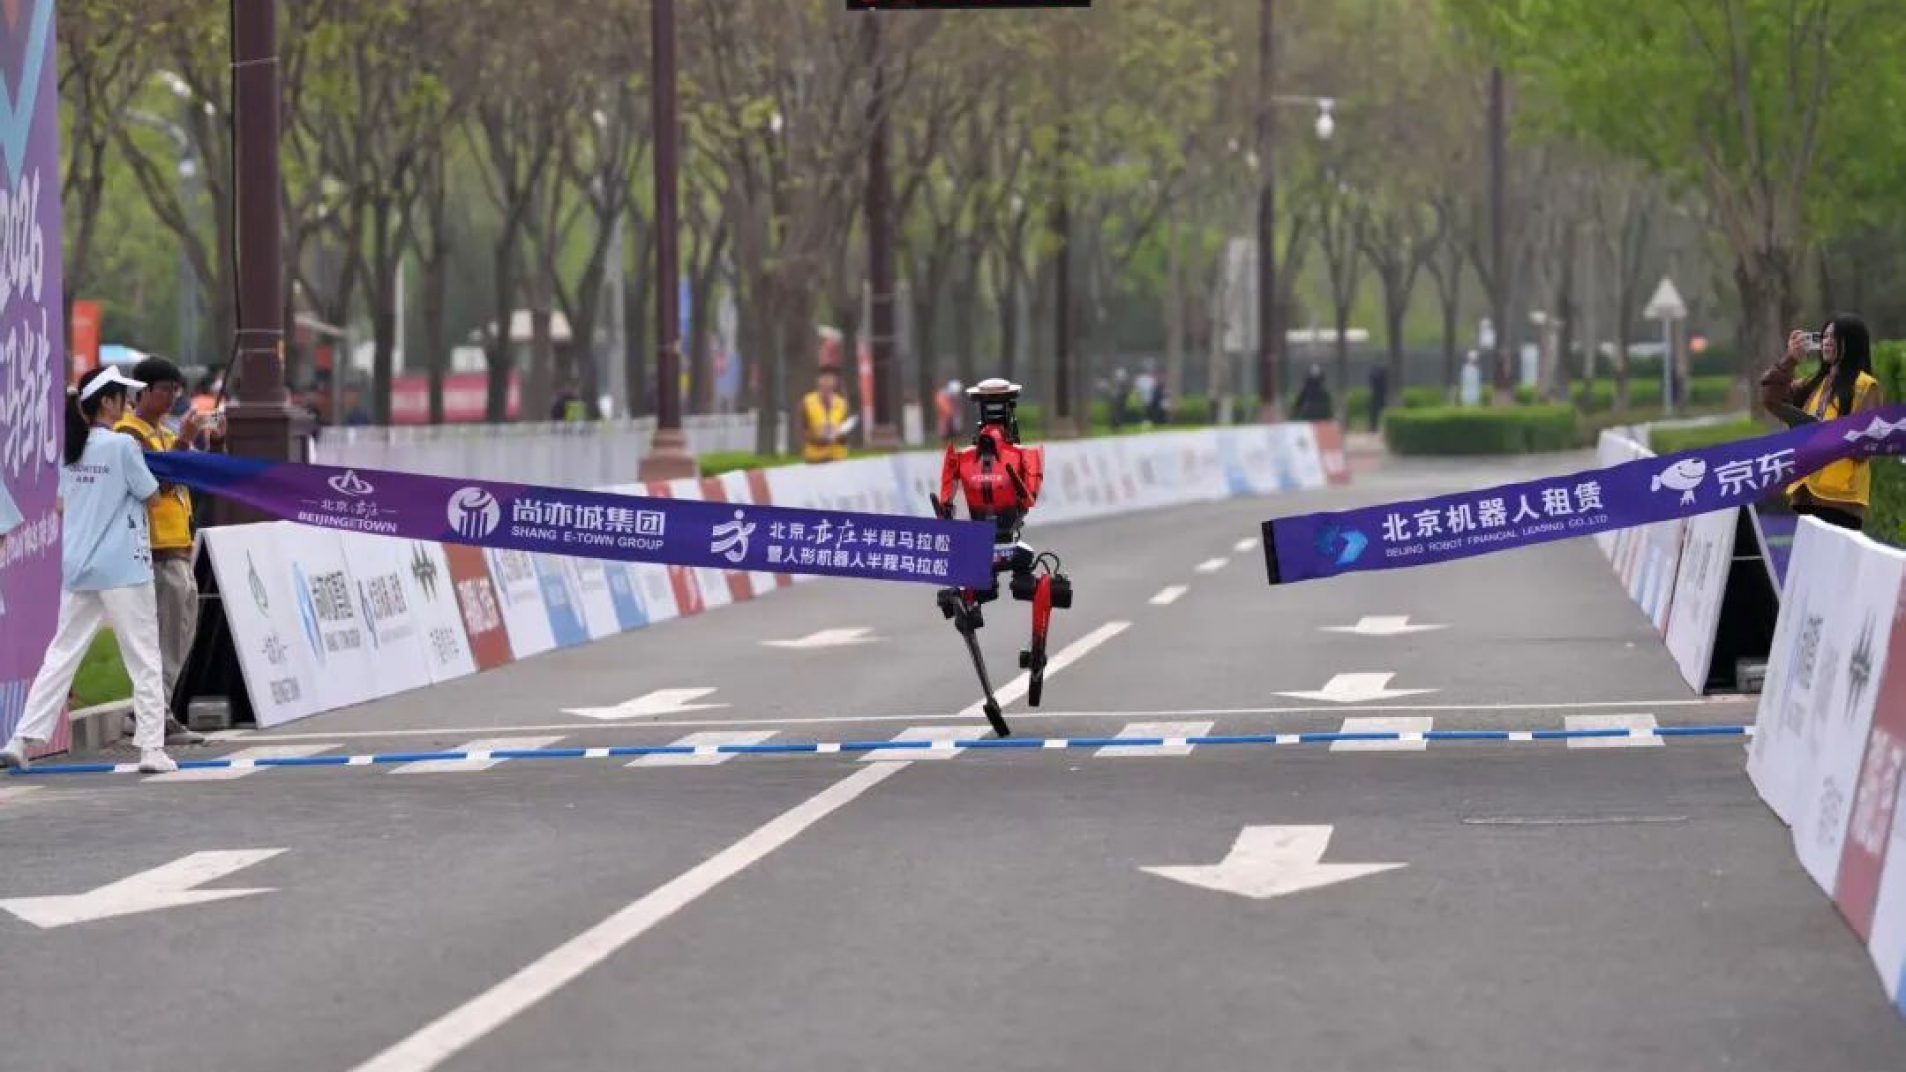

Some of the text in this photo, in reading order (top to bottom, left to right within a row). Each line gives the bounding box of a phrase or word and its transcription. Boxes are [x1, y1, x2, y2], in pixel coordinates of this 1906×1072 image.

[1714, 448, 1796, 497] 京东
[512, 498, 666, 536] 尚亦城集团
[1382, 481, 1604, 542] 北京机器人租赁
[511, 525, 664, 550] SHANG E-TOWN GROUP
[768, 518, 950, 552] 北京亦庄半程马拉松
[1386, 543, 1424, 557] BEIJING
[1429, 539, 1462, 552] ROBOT
[1467, 531, 1517, 545] FINANCIAL
[1523, 522, 1564, 535] LEASING
[767, 544, 948, 576] 暨人形机器人半程马拉松
